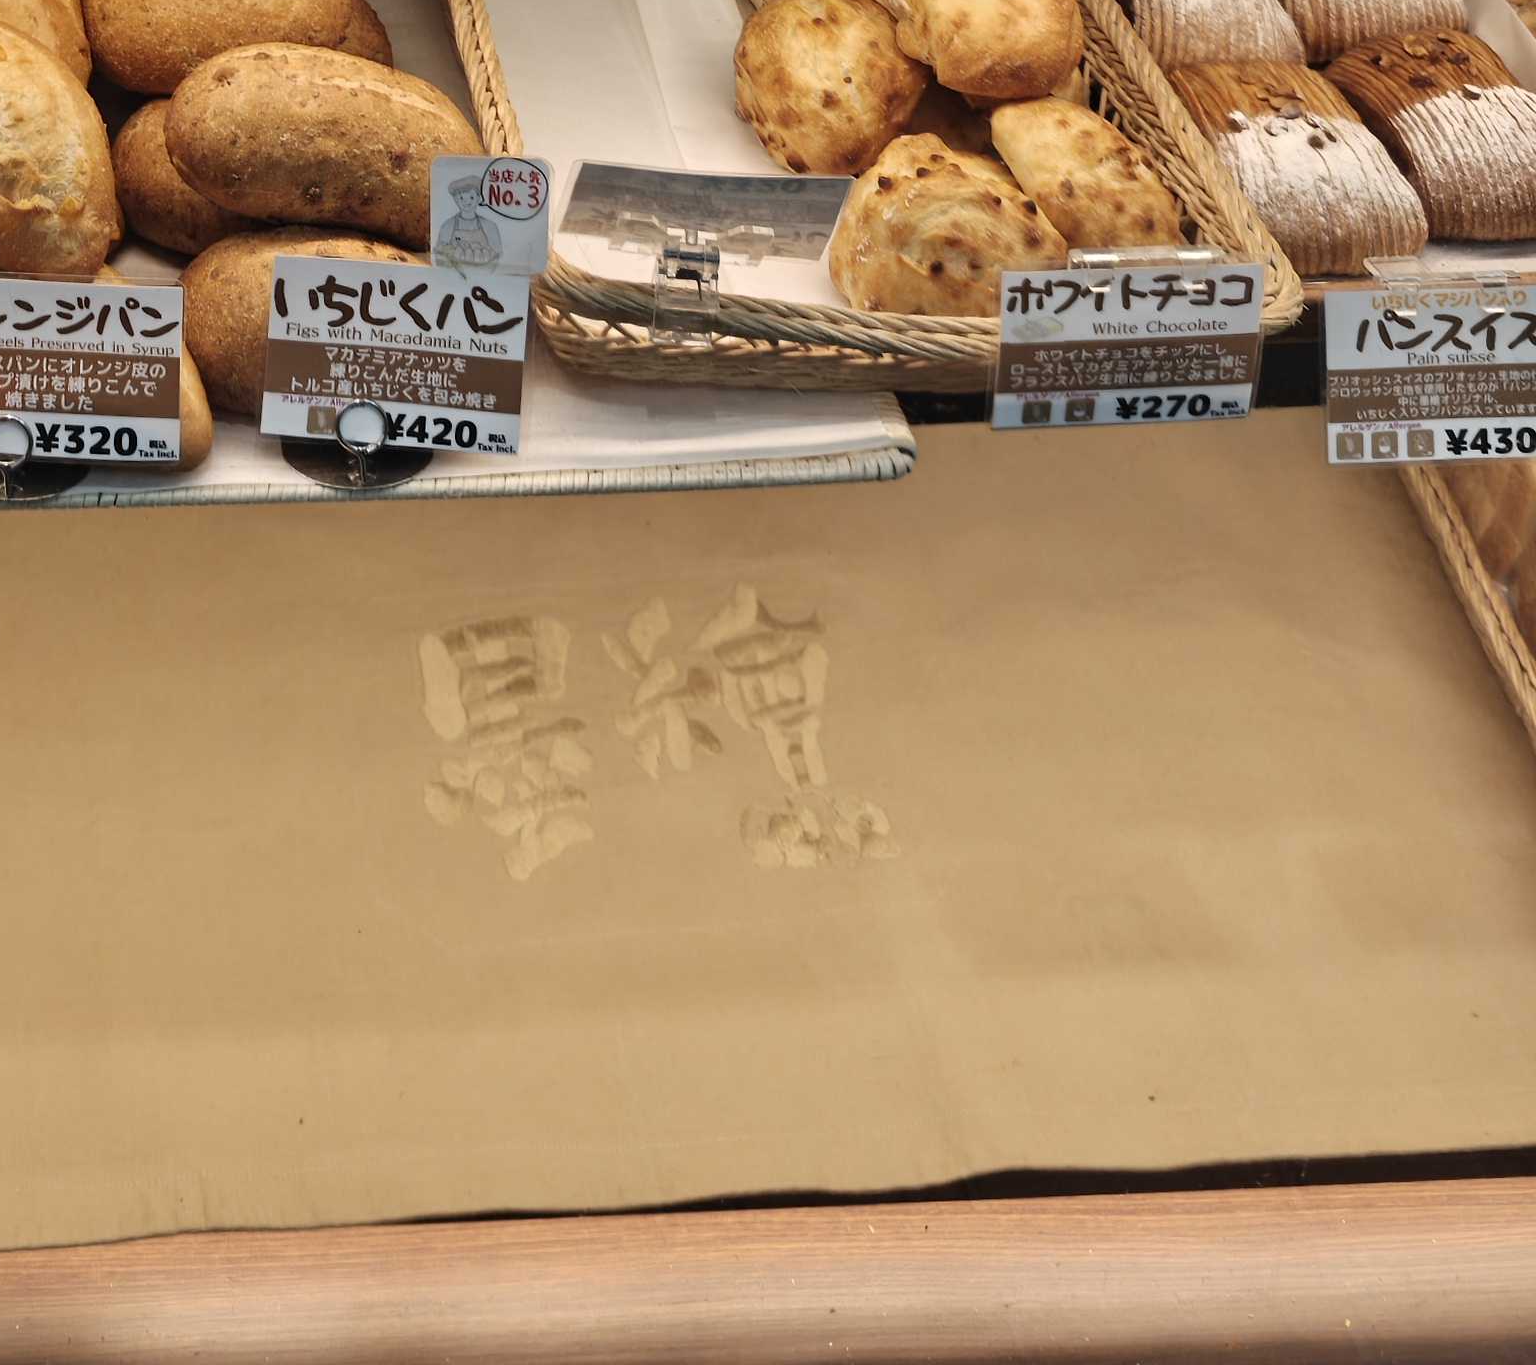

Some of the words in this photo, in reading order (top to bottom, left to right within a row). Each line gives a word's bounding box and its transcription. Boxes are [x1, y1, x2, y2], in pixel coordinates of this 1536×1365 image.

[274, 275, 523, 334] いちじくパン
[1007, 274, 1254, 314] ホワイトチョコ
[286, 322, 320, 339] Figs
[327, 326, 362, 340] with
[370, 328, 462, 350] Macadamia
[469, 339, 508, 354] Nuts
[1092, 323, 1138, 335] White
[1146, 319, 1228, 333] Chocolate
[1357, 309, 1536, 352] パンスイス
[31, 338, 105, 352] Preserved
[113, 341, 125, 353] in
[132, 341, 174, 357] Syrup
[1407, 352, 1440, 365] Pain
[1448, 351, 1496, 363] suisse
[4, 393, 94, 411] 焼きました
[1116, 394, 1211, 419] ¥270
[35, 423, 137, 456] ¥320
[1445, 427, 1536, 455] ¥430
